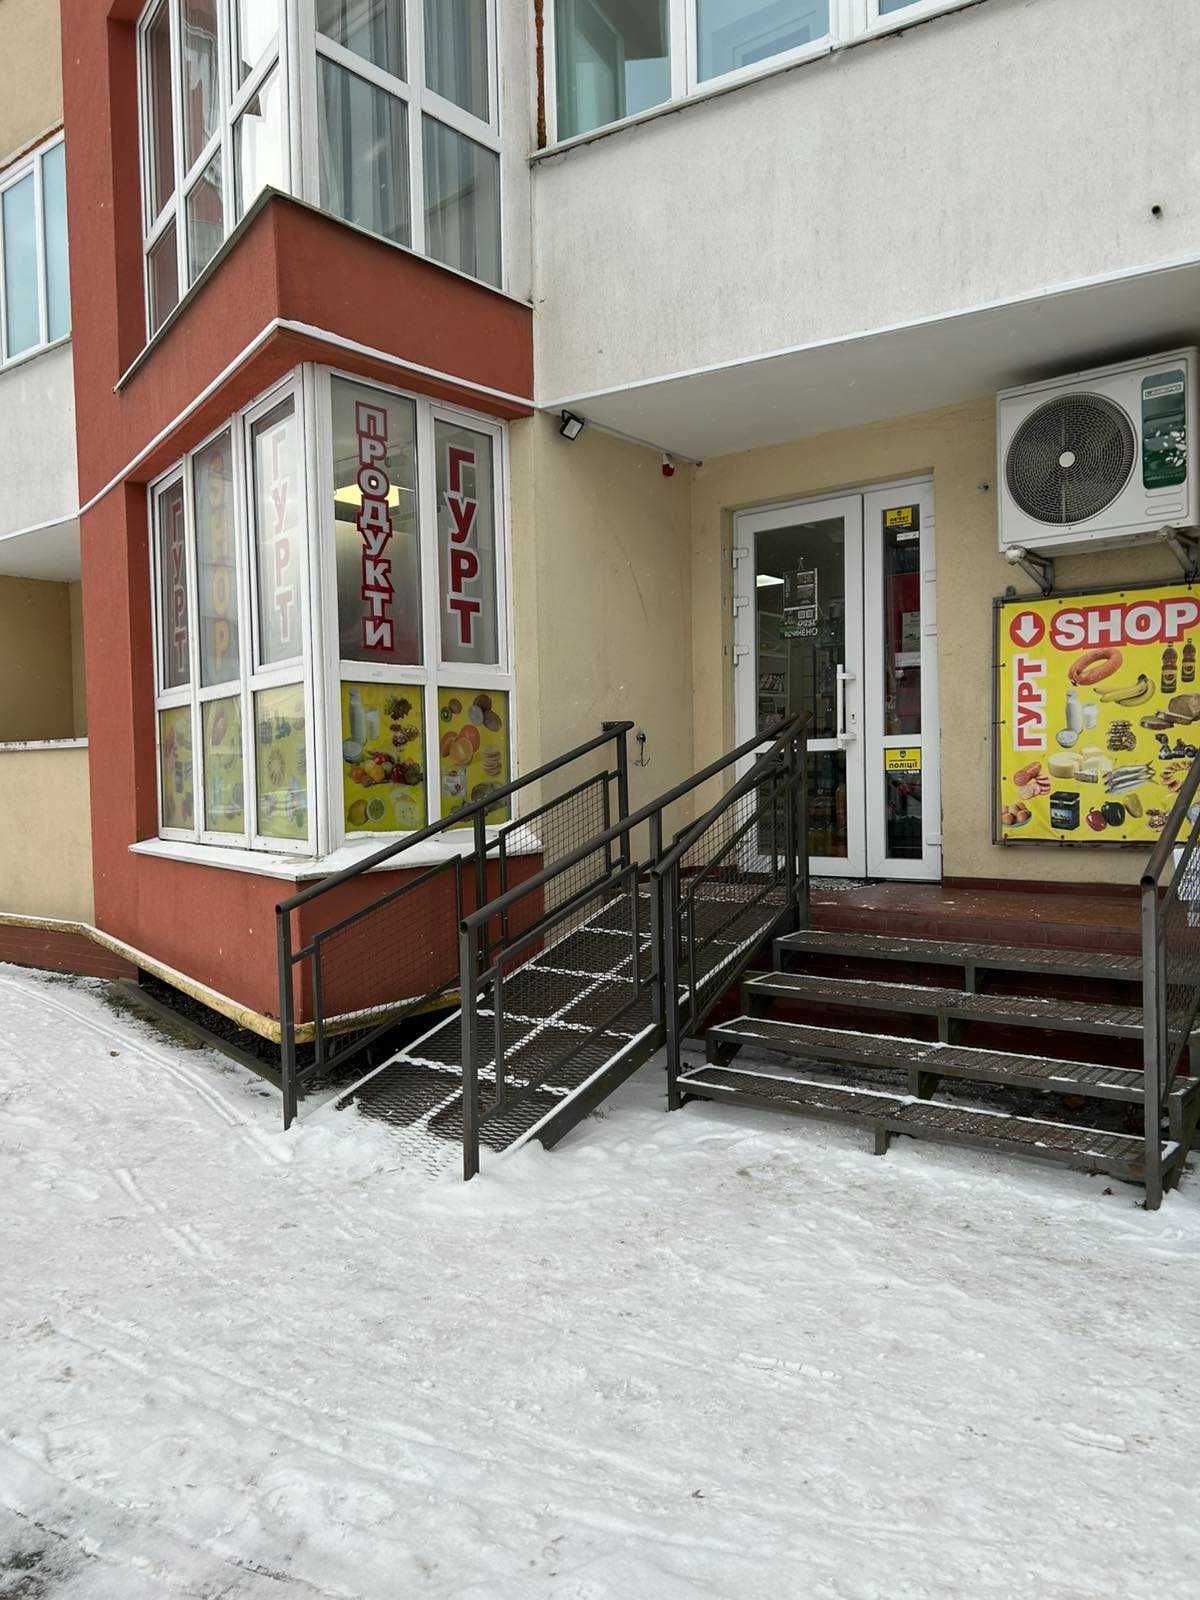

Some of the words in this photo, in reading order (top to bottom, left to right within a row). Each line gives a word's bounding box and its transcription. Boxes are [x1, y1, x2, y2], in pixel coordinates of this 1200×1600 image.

[171, 501, 189, 671] ГУРТ
[271, 427, 293, 642] ГУРТ
[357, 402, 393, 649] ПРОДУКТИ
[447, 445, 481, 645] ГУРТ
[1016, 656, 1044, 748] ГУРТ
[1053, 600, 1199, 648] SHOP
